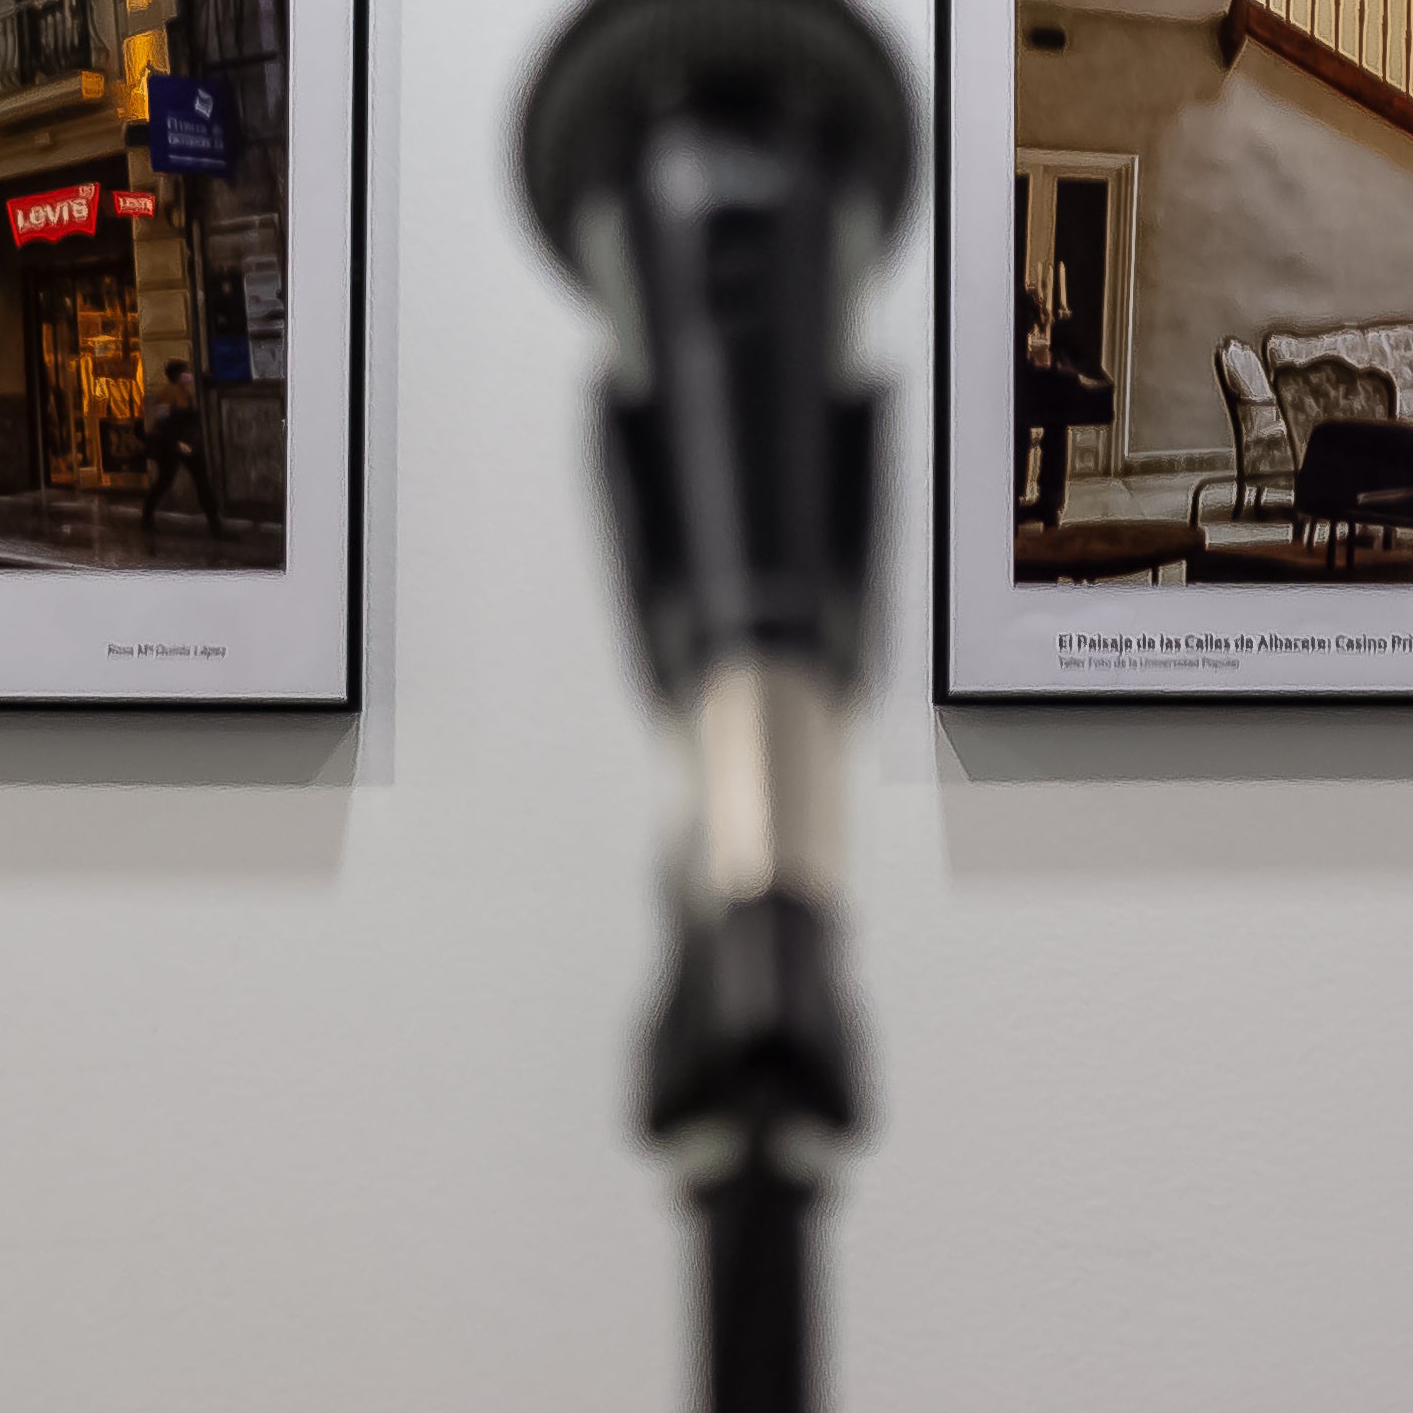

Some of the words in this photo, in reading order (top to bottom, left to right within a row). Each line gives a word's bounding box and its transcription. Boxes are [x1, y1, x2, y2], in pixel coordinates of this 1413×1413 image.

[1058, 633, 1073, 652] El
[1077, 633, 1133, 655] Paisaje
[1136, 633, 1156, 651] de
[1159, 633, 1181, 652] las
[1185, 633, 1231, 651] Calles
[1234, 633, 1254, 651] de
[1335, 634, 1388, 653] Casino
